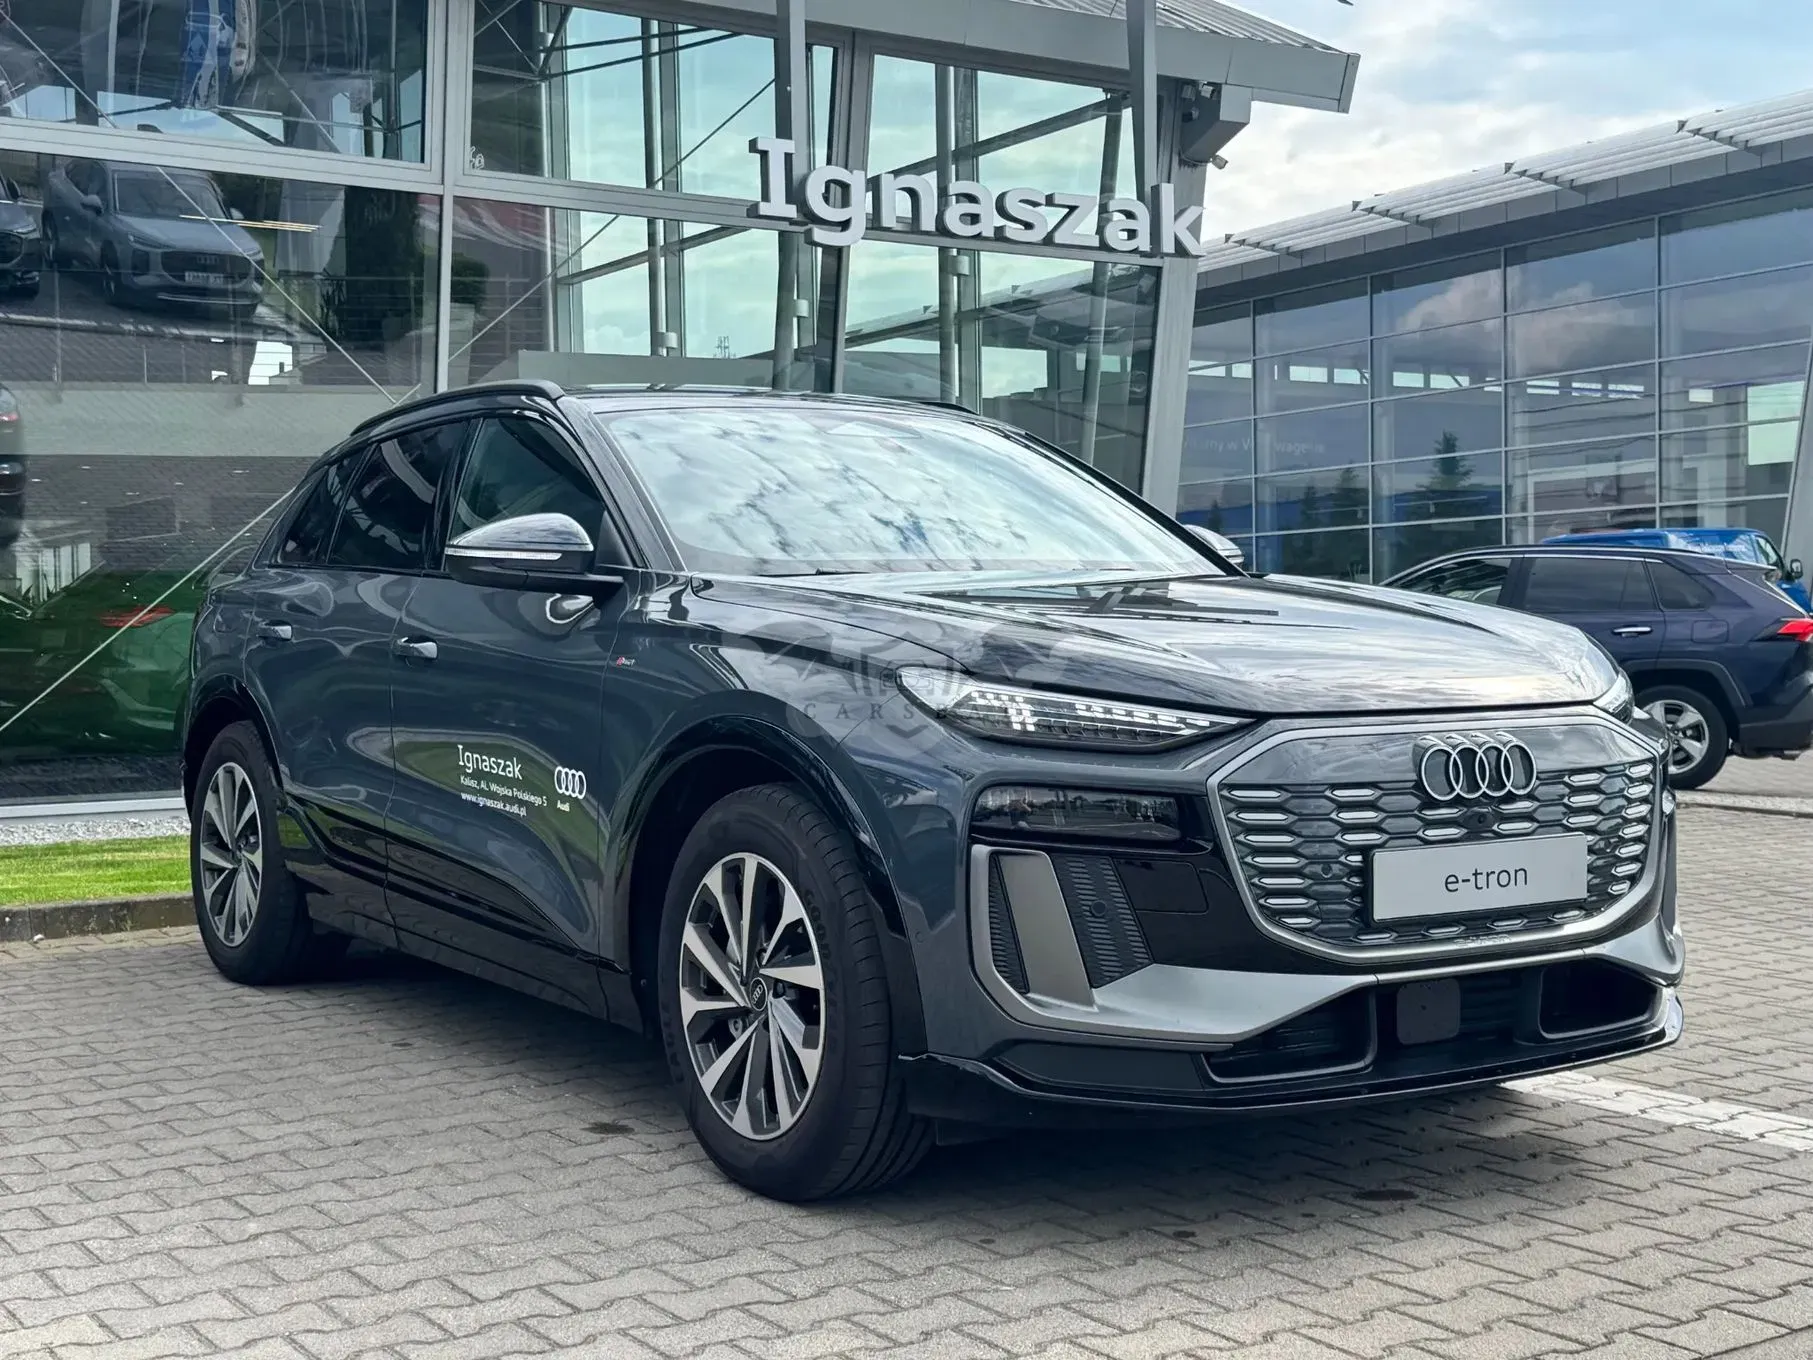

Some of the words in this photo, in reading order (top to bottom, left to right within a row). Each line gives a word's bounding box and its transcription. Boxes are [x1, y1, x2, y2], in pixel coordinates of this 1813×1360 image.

[748, 136, 1206, 258] Ignaszak
[457, 744, 523, 780] Ignaszak
[460, 791, 527, 818] www.ignaszak.audi.pl
[489, 782, 513, 798] Wojska
[513, 788, 542, 807] Polskiego
[556, 800, 570, 812] Audi
[1444, 867, 1528, 892] e-tron
